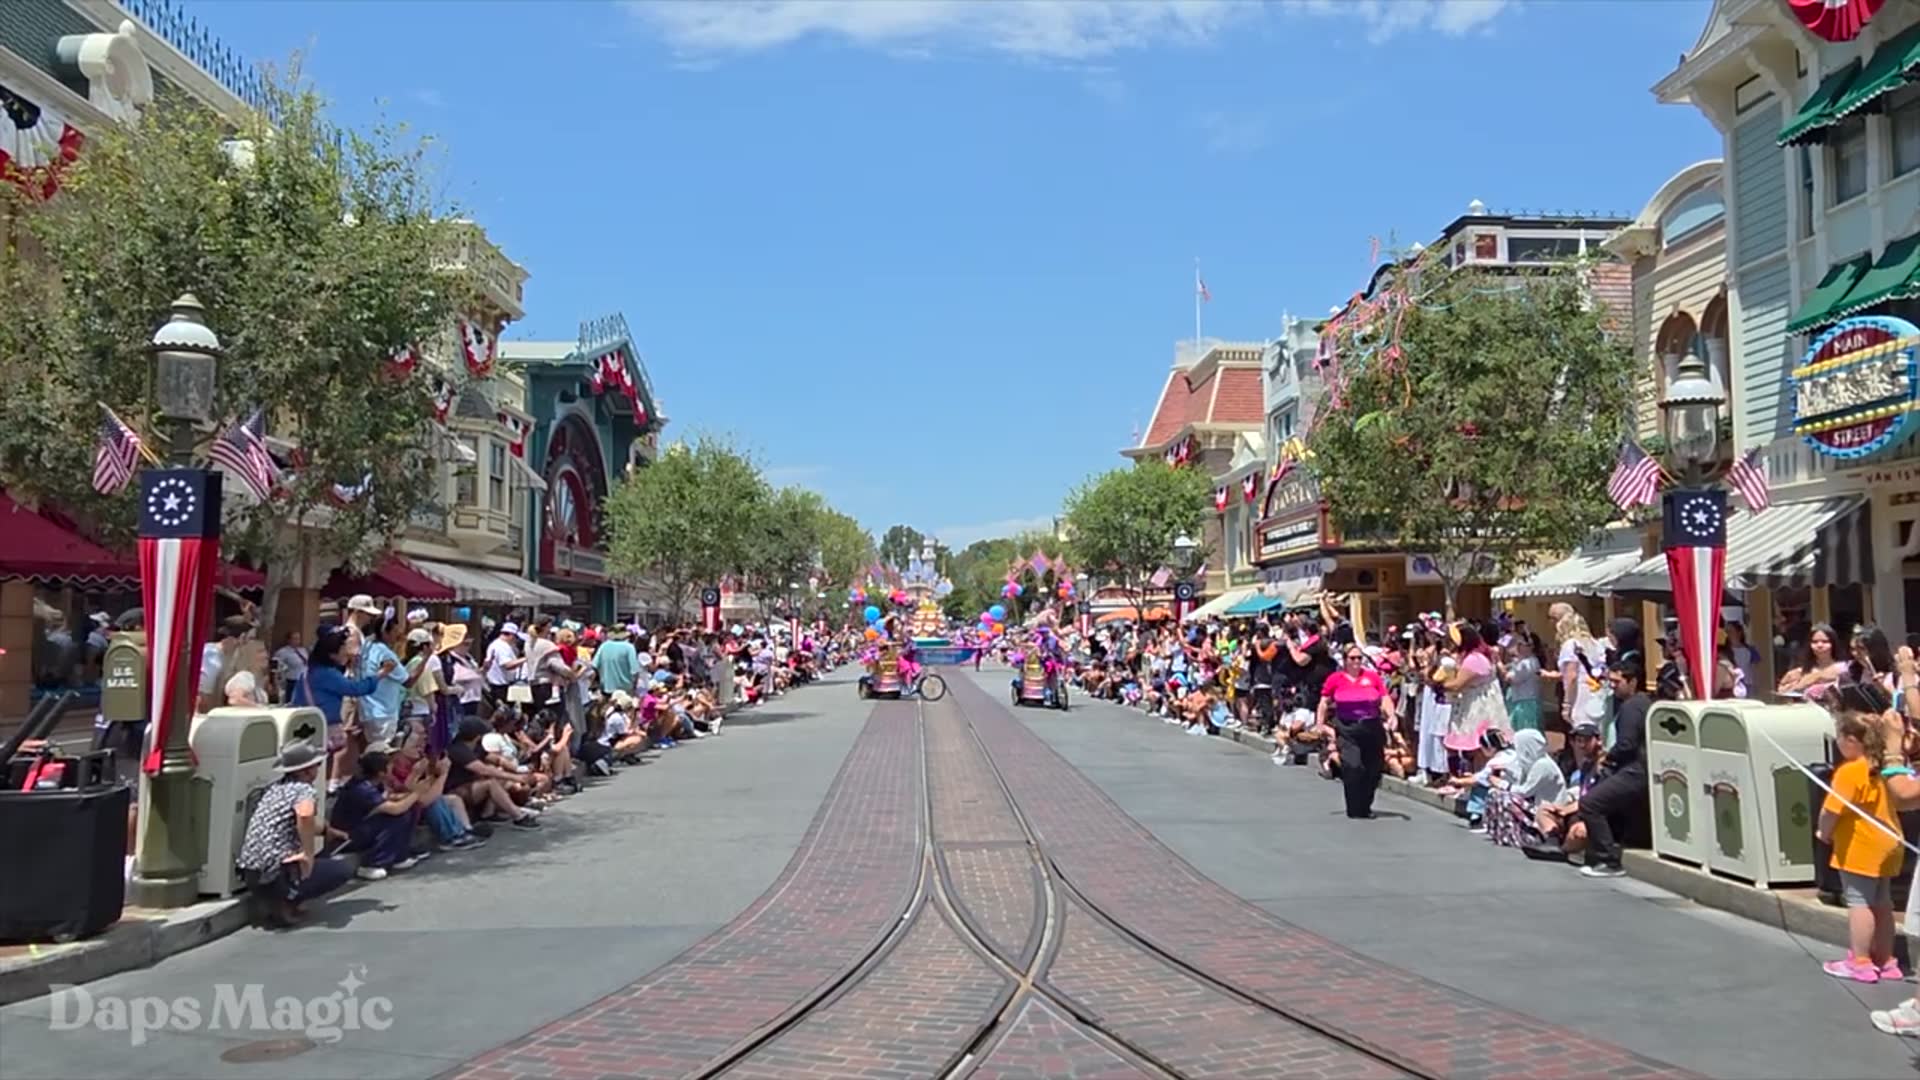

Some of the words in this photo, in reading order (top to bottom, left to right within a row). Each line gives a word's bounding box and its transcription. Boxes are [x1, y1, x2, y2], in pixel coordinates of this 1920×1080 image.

[1833, 333, 1868, 355] MAIN
[1832, 424, 1873, 446] STREET
[106, 678, 139, 688] MAIL
